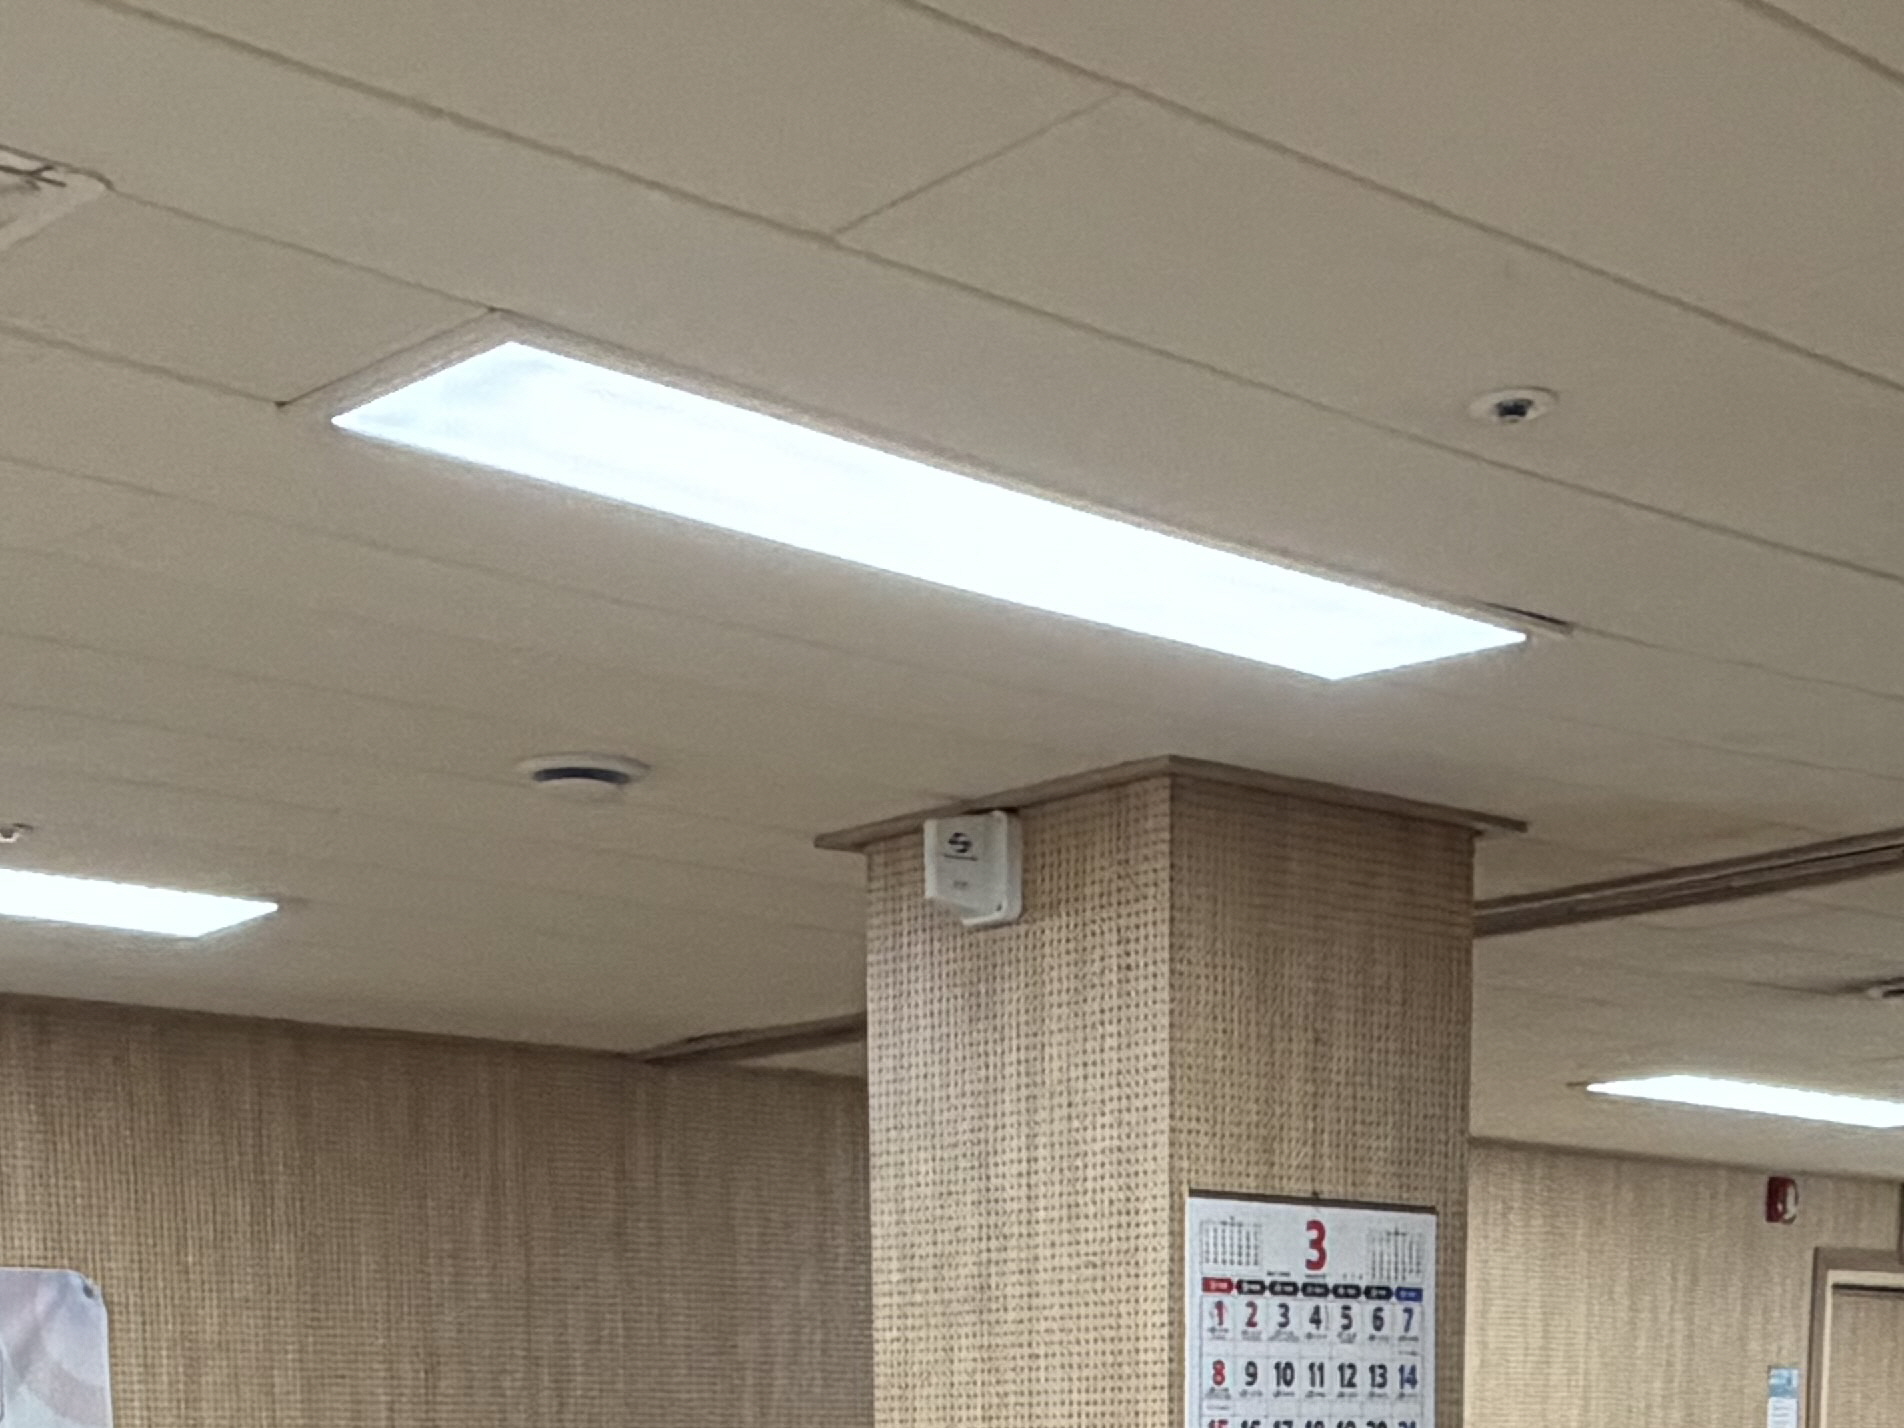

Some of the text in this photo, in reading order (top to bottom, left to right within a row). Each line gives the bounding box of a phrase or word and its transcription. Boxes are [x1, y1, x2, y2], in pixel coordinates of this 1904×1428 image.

[1304, 1218, 1328, 1272] 3
[1214, 1300, 1414, 1333] 1 2 3 4 5 6 7
[1212, 1359, 1418, 1389] 8 9 10 11 12 13 14
